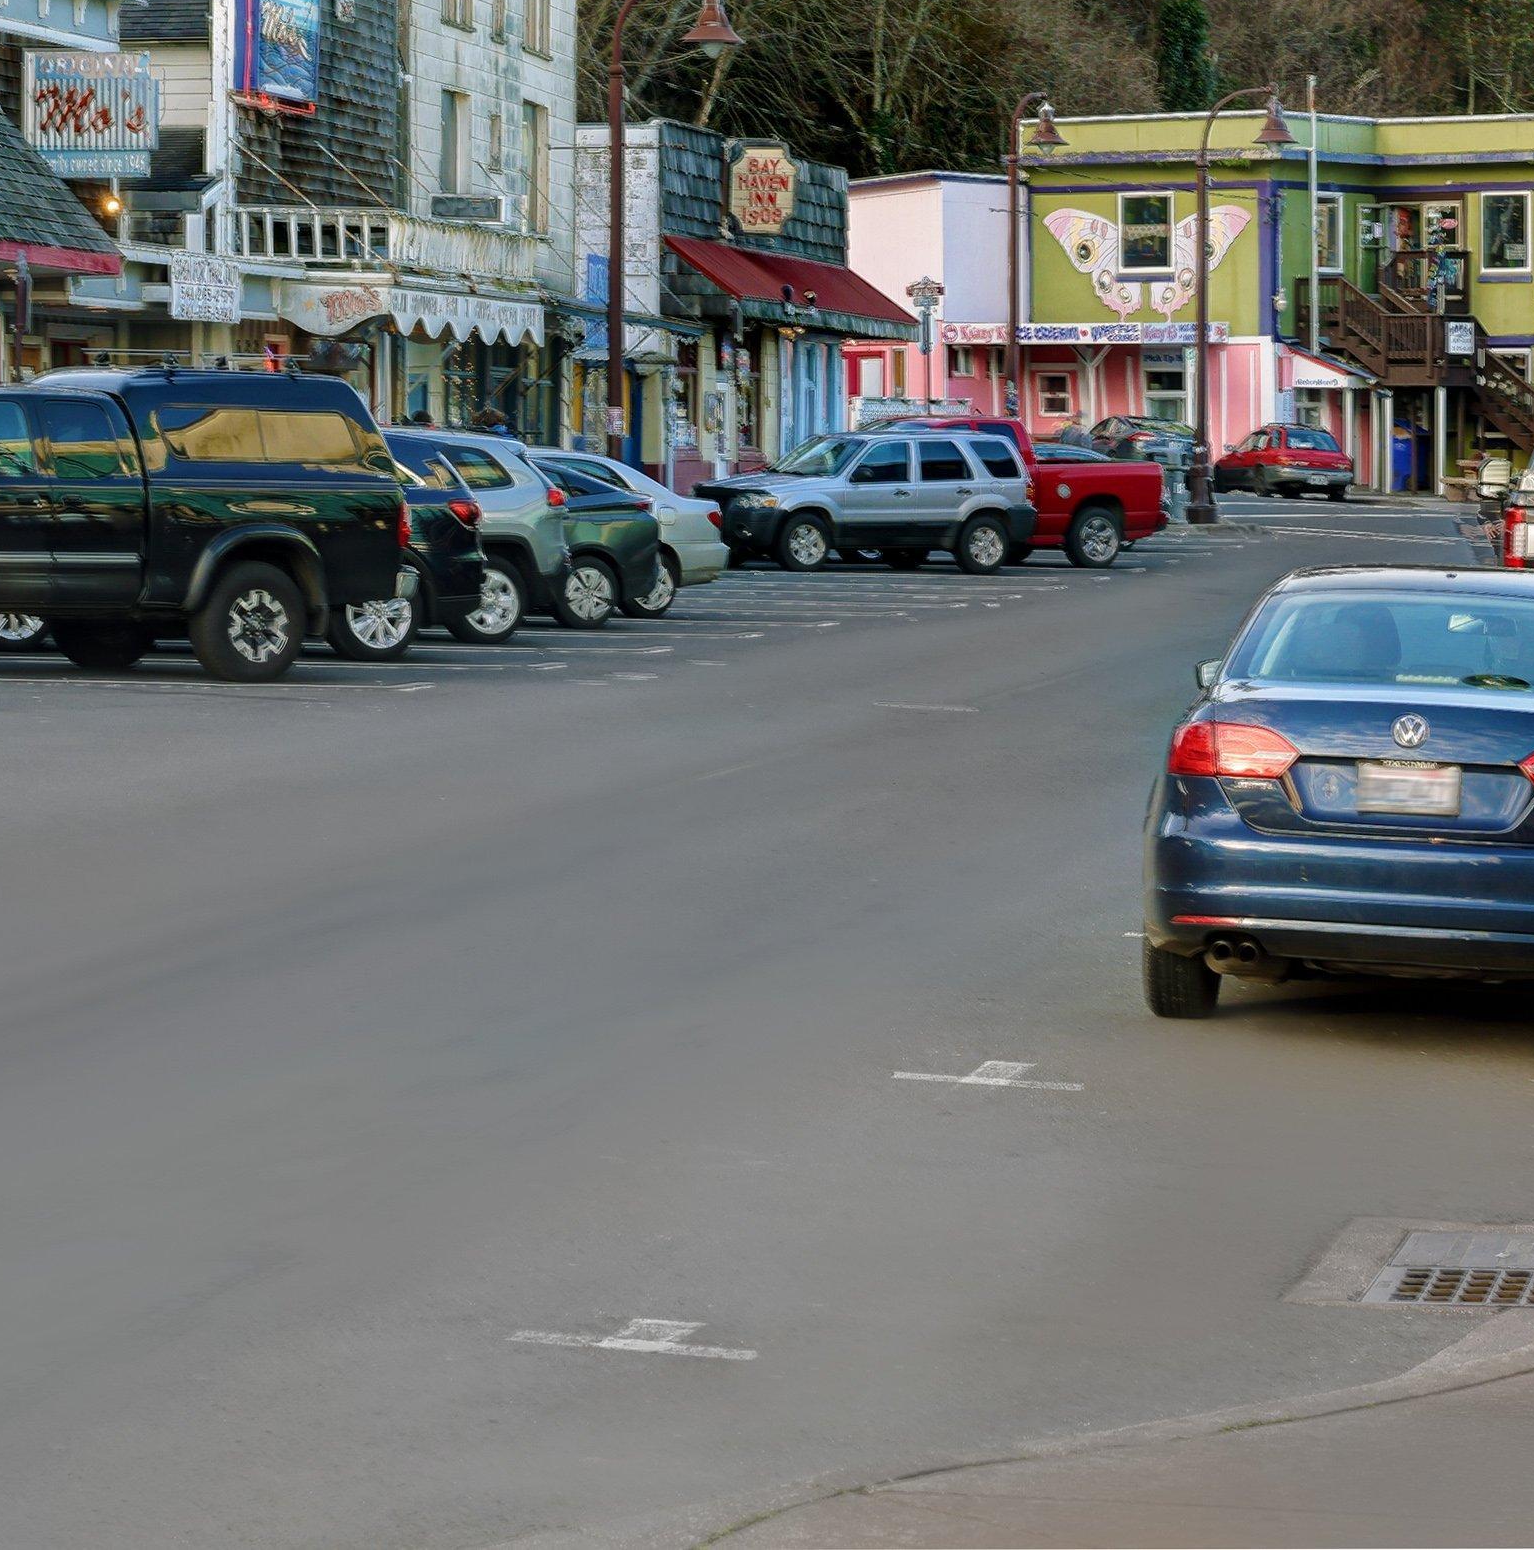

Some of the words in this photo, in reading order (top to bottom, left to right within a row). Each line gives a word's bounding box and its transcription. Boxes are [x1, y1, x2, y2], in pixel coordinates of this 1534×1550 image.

[34, 84, 148, 134] Mo's
[749, 158, 780, 174] BAY
[738, 174, 789, 191] HAVEN
[749, 191, 777, 206] INN
